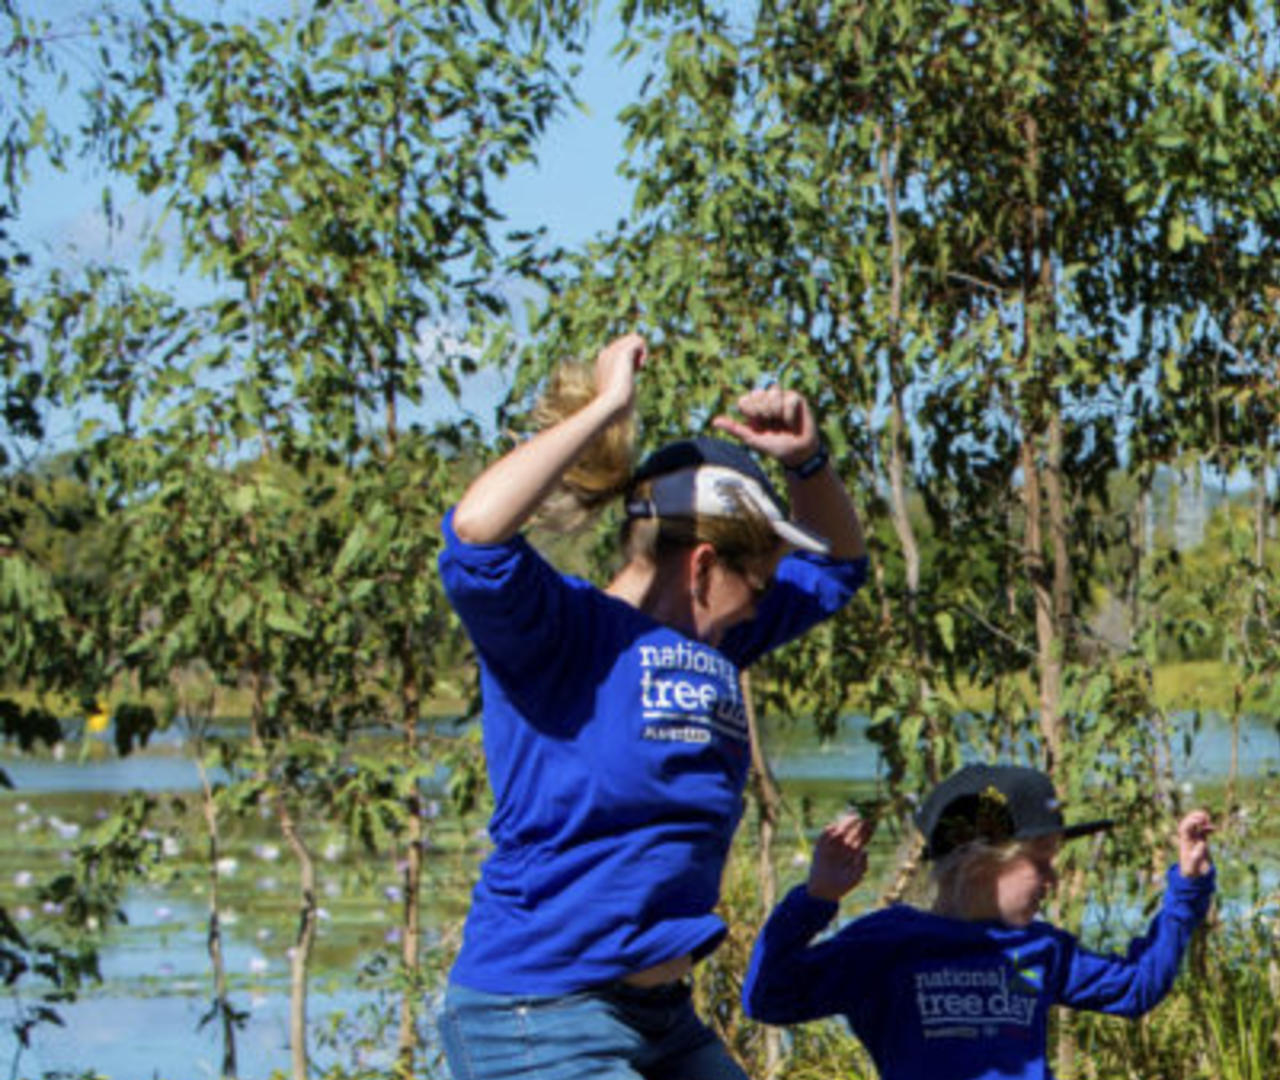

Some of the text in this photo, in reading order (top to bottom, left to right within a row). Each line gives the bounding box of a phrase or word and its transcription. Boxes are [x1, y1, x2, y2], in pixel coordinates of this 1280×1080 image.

[640, 669, 717, 711] tree
[914, 965, 1007, 990] national
[916, 988, 1038, 1026] tree day
